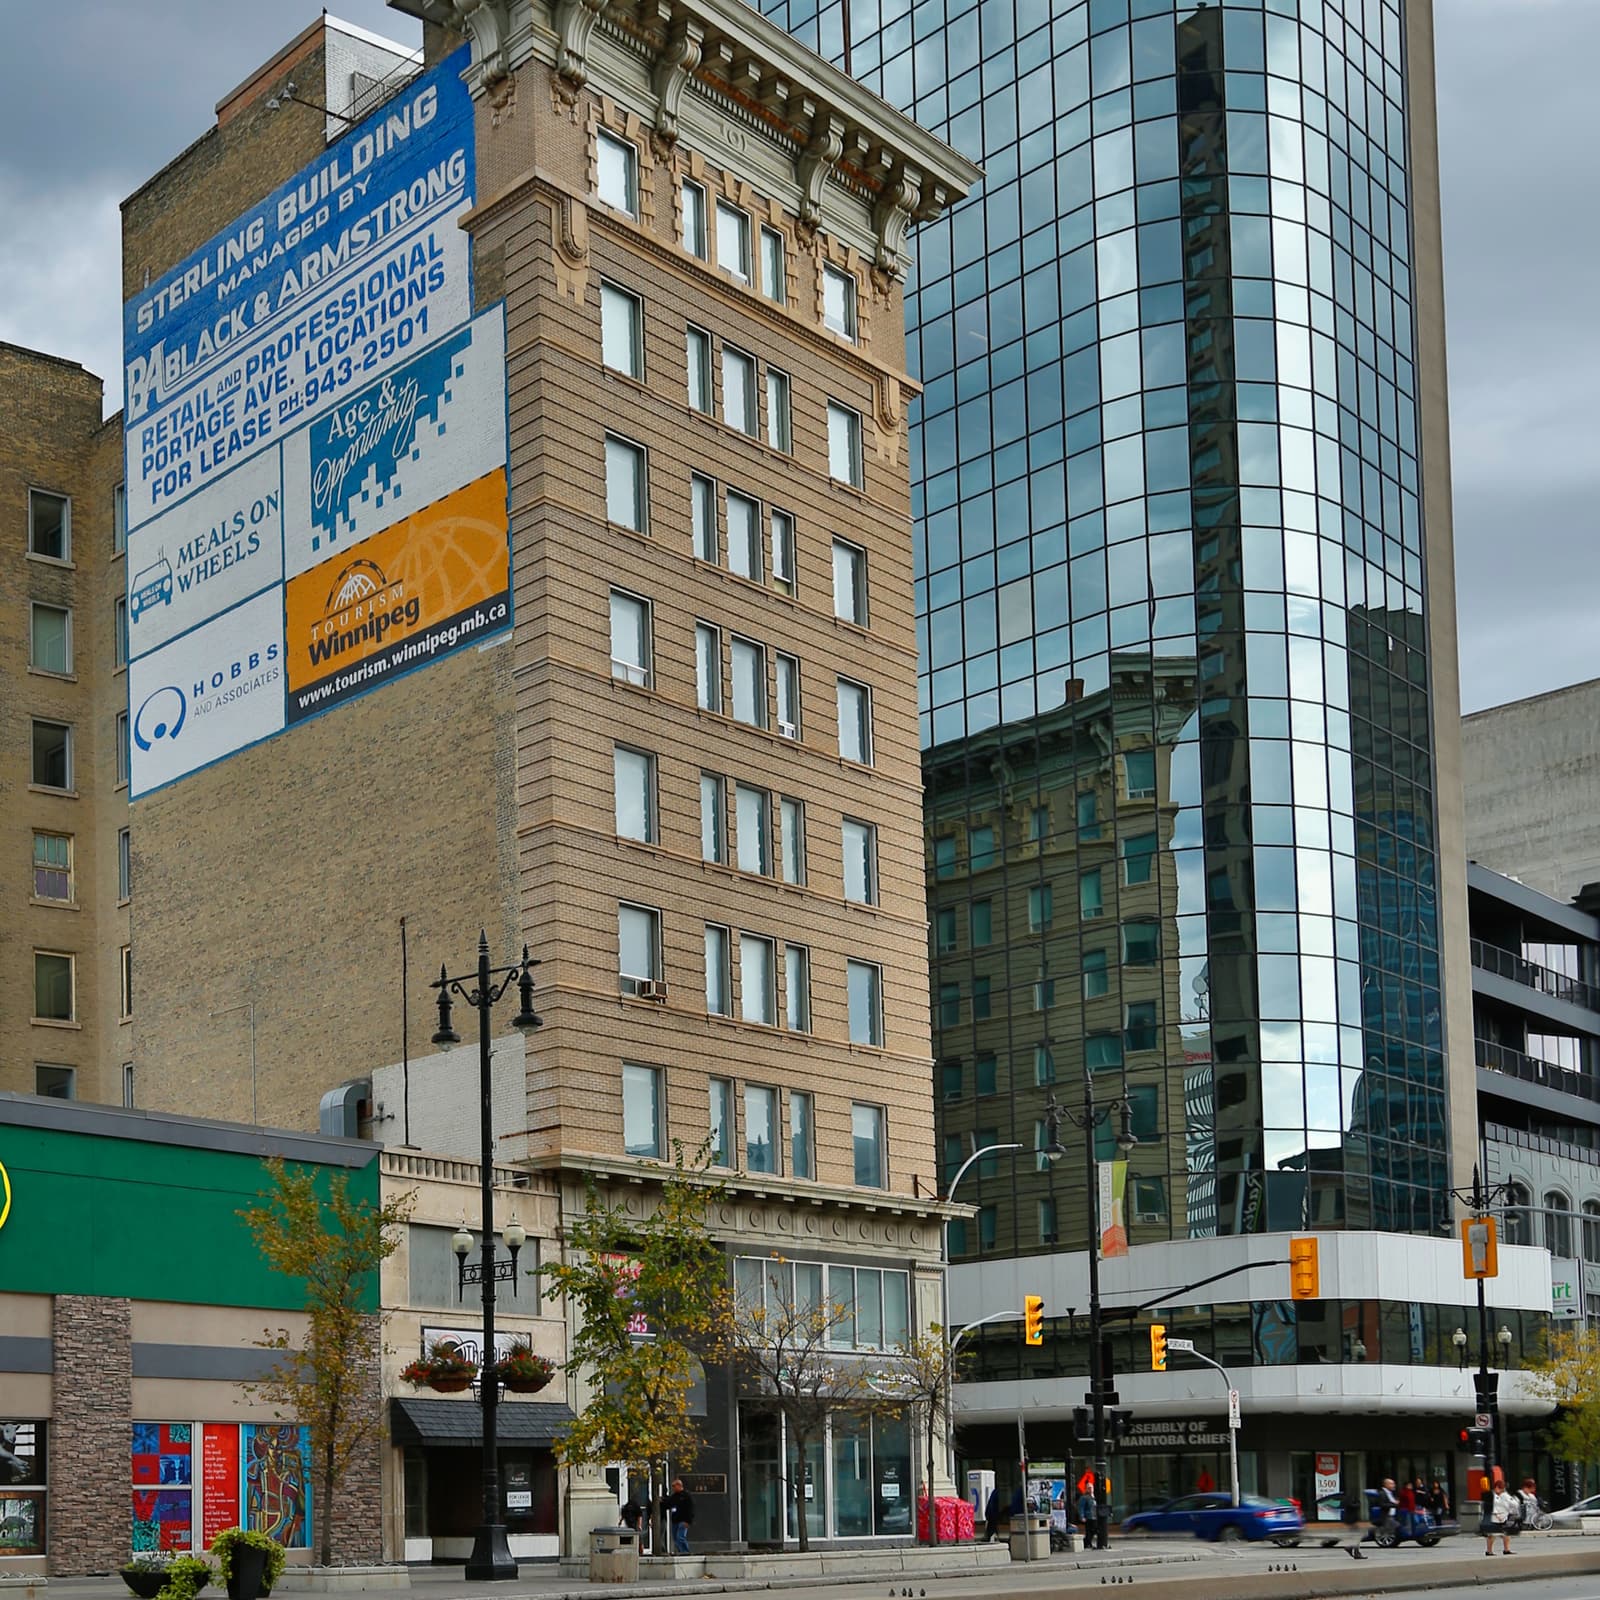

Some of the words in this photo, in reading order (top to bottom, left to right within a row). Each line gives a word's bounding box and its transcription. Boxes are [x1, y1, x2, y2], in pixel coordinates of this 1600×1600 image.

[137, 216, 264, 334] STERLING
[277, 84, 438, 231] BUILDING
[217, 205, 329, 301] MANAGED
[338, 173, 373, 212] BY
[165, 300, 248, 387] BLACK
[254, 291, 272, 323] &
[277, 148, 466, 309] ARMSTRONG
[142, 388, 215, 454] RETAIL
[216, 369, 242, 395] AND
[246, 232, 444, 385] PROFESSIONAL
[142, 399, 236, 481] PORTAGE
[243, 365, 294, 415] AVE.
[304, 261, 445, 375] LOCATIONS
[313, 377, 429, 515] Opportunity
[327, 400, 371, 444] Age
[378, 378, 397, 410] &
[152, 460, 192, 505] FOR
[200, 408, 272, 474] LEASE
[177, 510, 245, 570] MEALS
[250, 489, 279, 525] ON
[177, 530, 261, 593] WHEELS
[308, 596, 420, 666] Winnipeg
[310, 584, 405, 641] TOURISM
[193, 643, 279, 699] HOBBS
[194, 700, 213, 719] AND
[215, 667, 280, 709] ASSOCIATES
[1101, 1166, 1111, 1229] PORTAGE
[1120, 1434, 1186, 1447] MANITOBA
[1188, 1432, 1232, 1445] CHIEFS
[1188, 1421, 1208, 1432] OF
